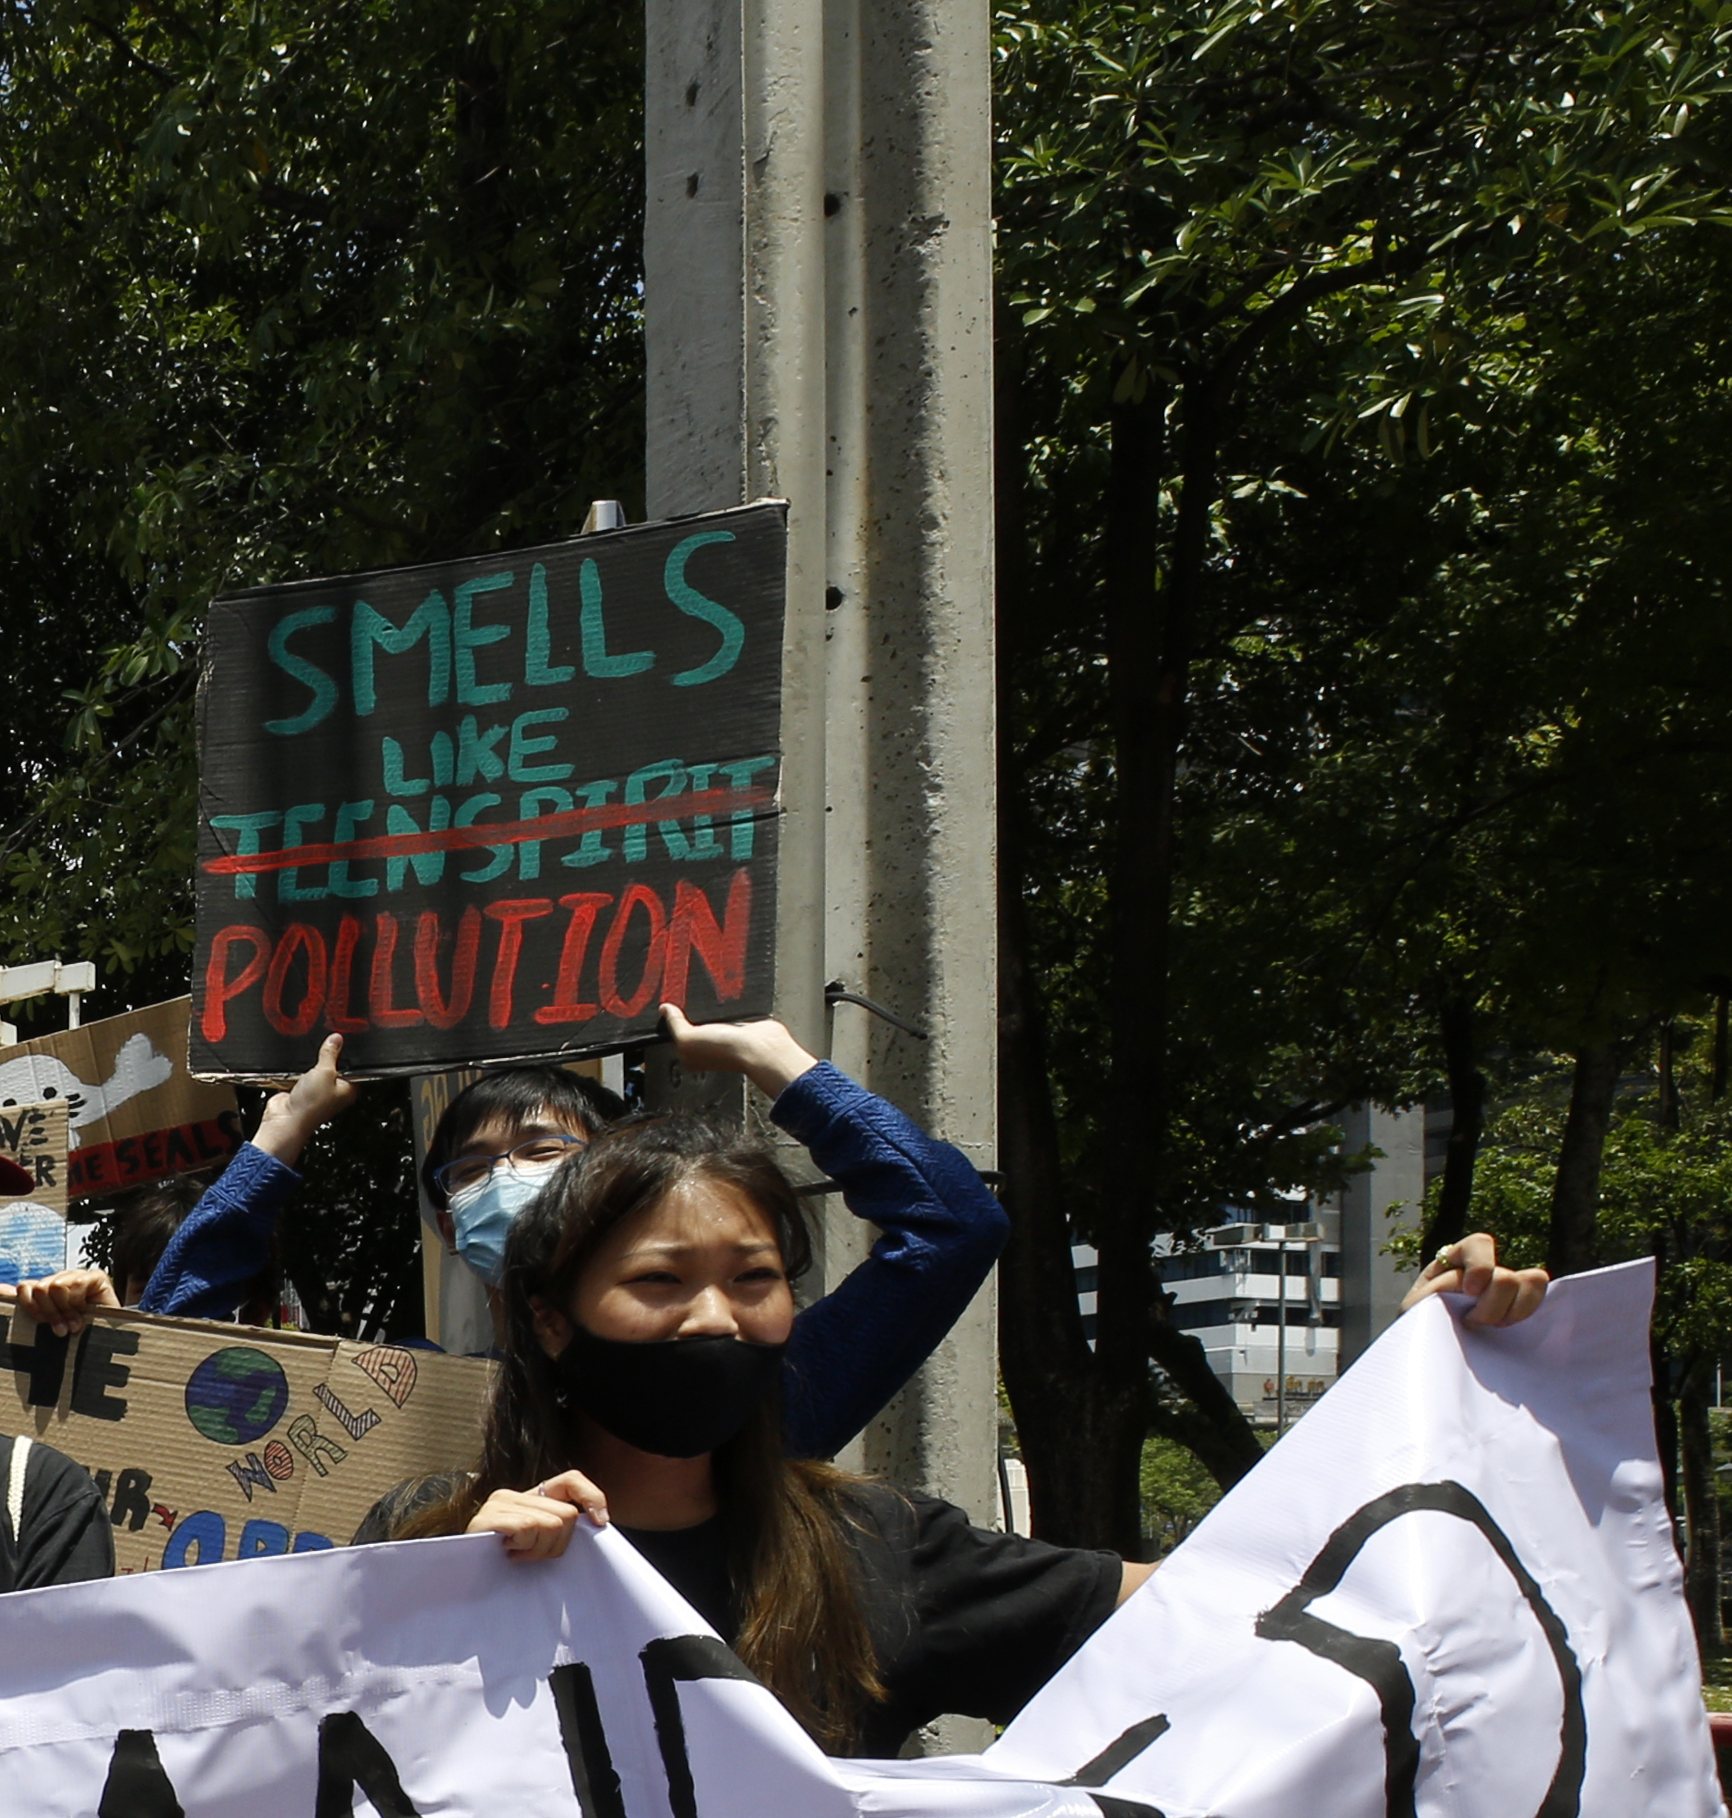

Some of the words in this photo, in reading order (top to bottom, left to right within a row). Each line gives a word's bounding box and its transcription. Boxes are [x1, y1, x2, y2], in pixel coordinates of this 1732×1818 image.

[262, 530, 745, 736] SMELLS
[382, 706, 576, 798] LIKE
[200, 868, 751, 1042] POLLUTION
[114, 1110, 239, 1177] SEALS
[225, 1344, 418, 1502] WORLD
